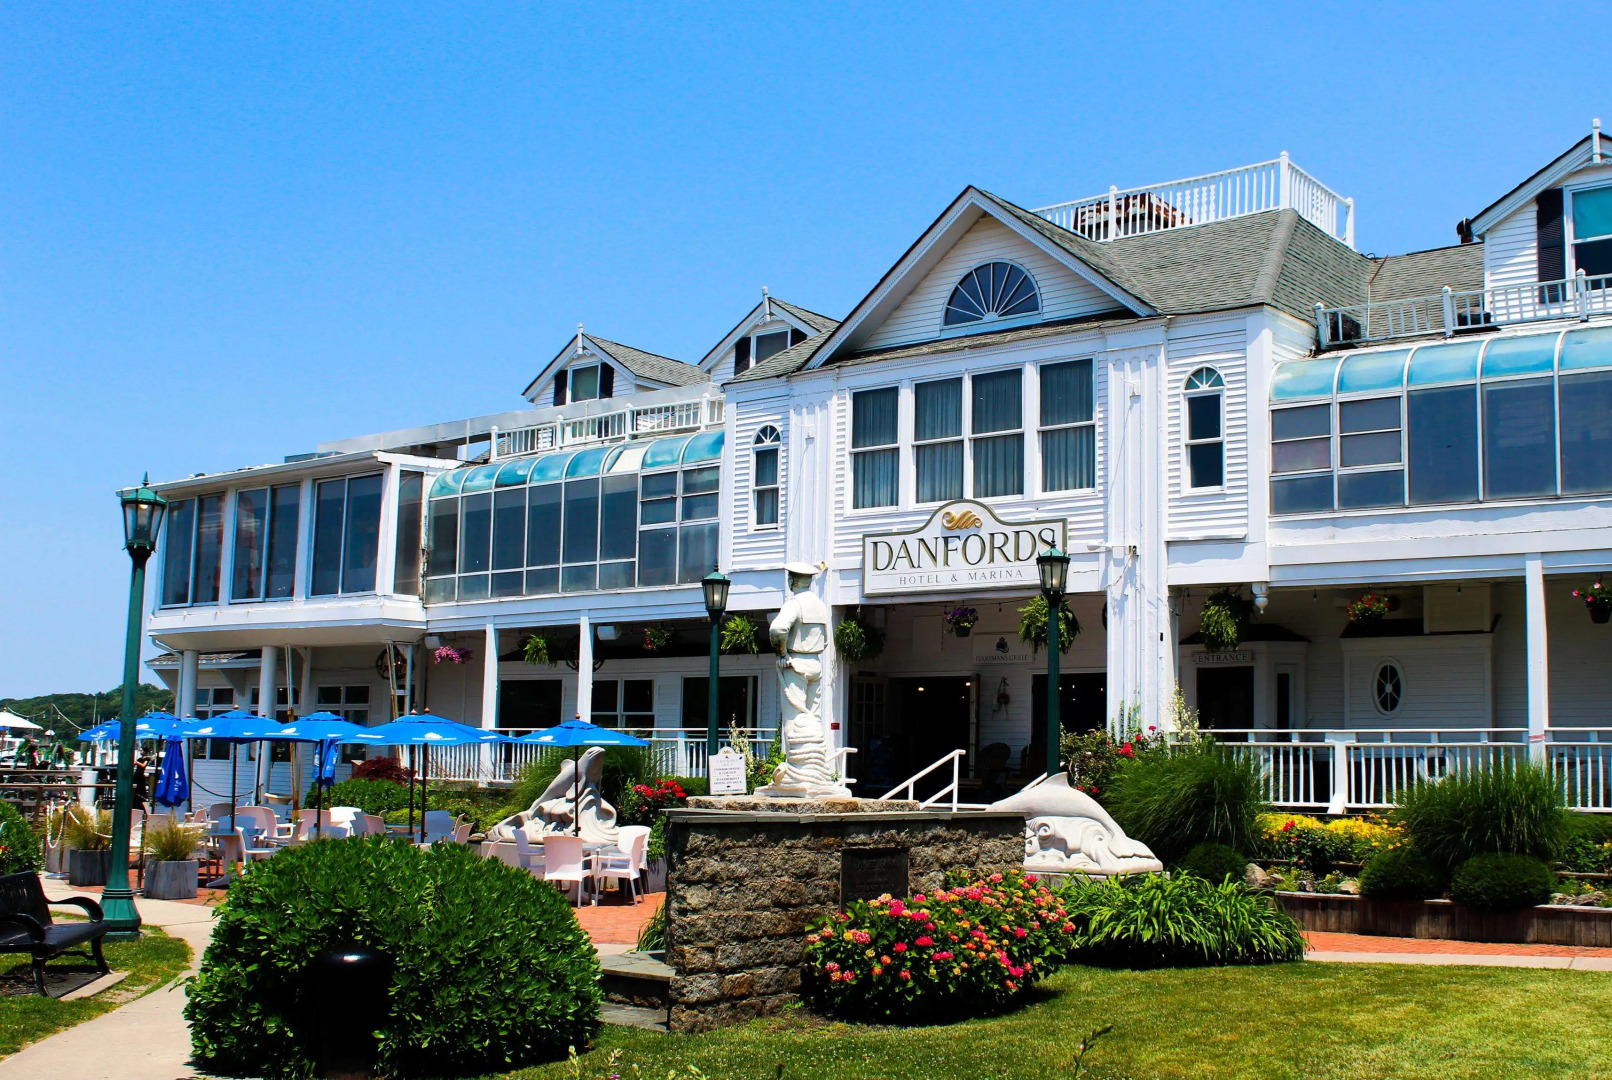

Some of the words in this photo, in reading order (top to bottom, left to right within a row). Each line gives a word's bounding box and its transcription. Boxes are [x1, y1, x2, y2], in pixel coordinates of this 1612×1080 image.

[870, 527, 1056, 571] DANFORDS
[899, 573, 941, 585] HOTEL
[950, 574, 958, 583] &
[967, 569, 1023, 581] MARINA
[1198, 653, 1248, 663] ENTRANCE
